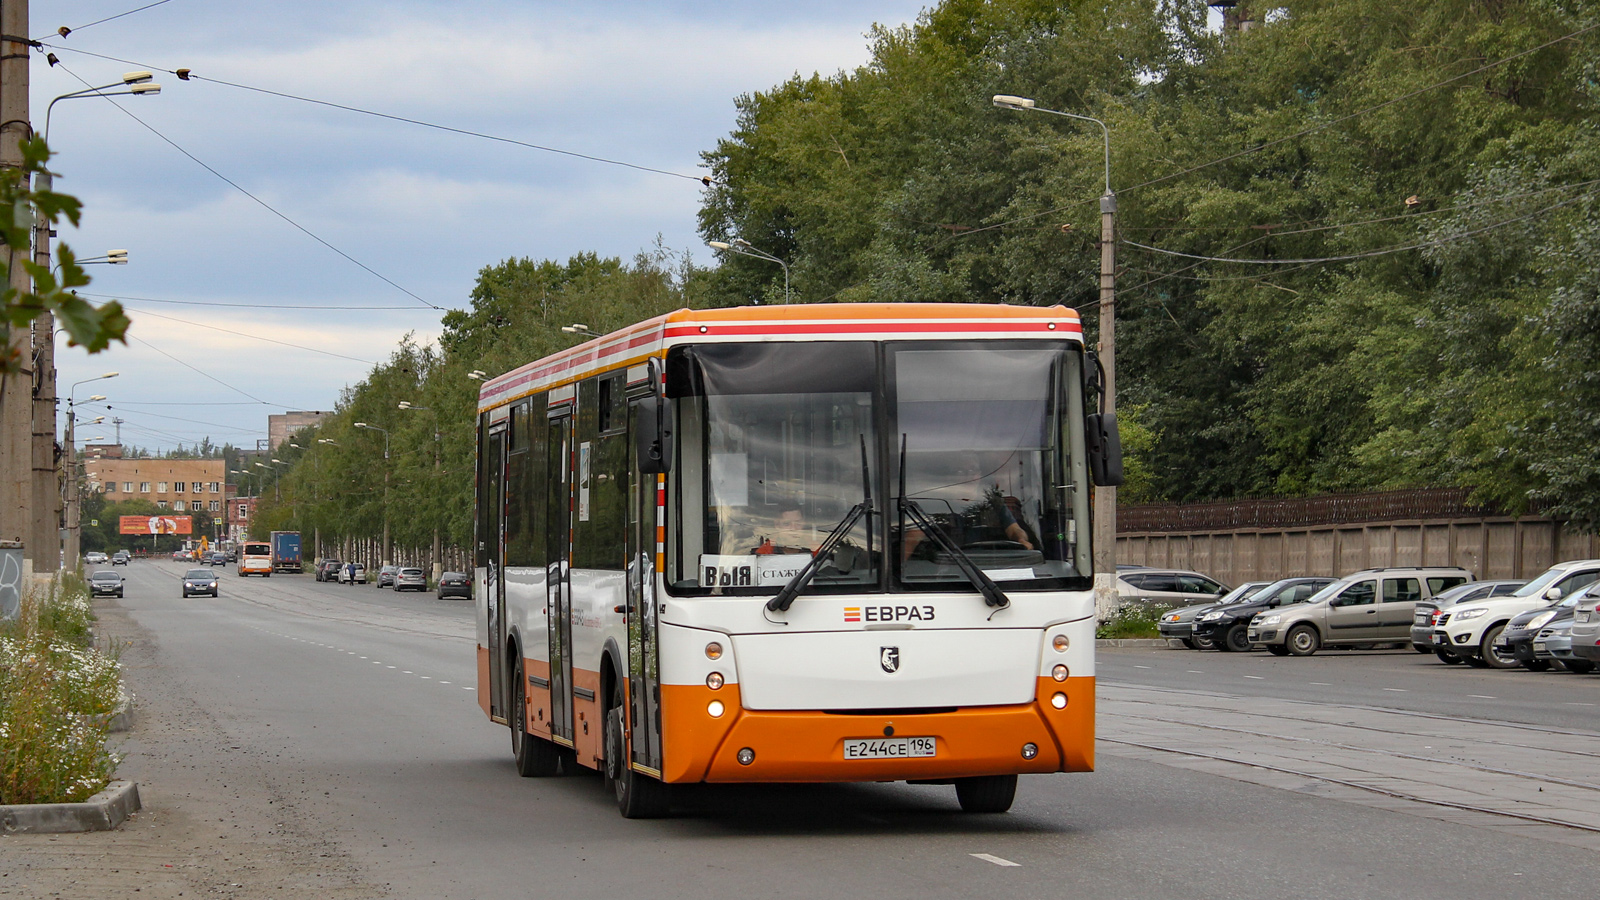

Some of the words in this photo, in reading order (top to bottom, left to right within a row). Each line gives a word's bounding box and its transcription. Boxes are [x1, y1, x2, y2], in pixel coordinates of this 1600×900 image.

[705, 566, 751, 586] ВЫЯ
[762, 569, 803, 578] СТАЖЕ
[865, 605, 935, 621] ЕВРАЗ
[849, 741, 907, 757] Е244СЕ
[910, 739, 932, 750] 196
